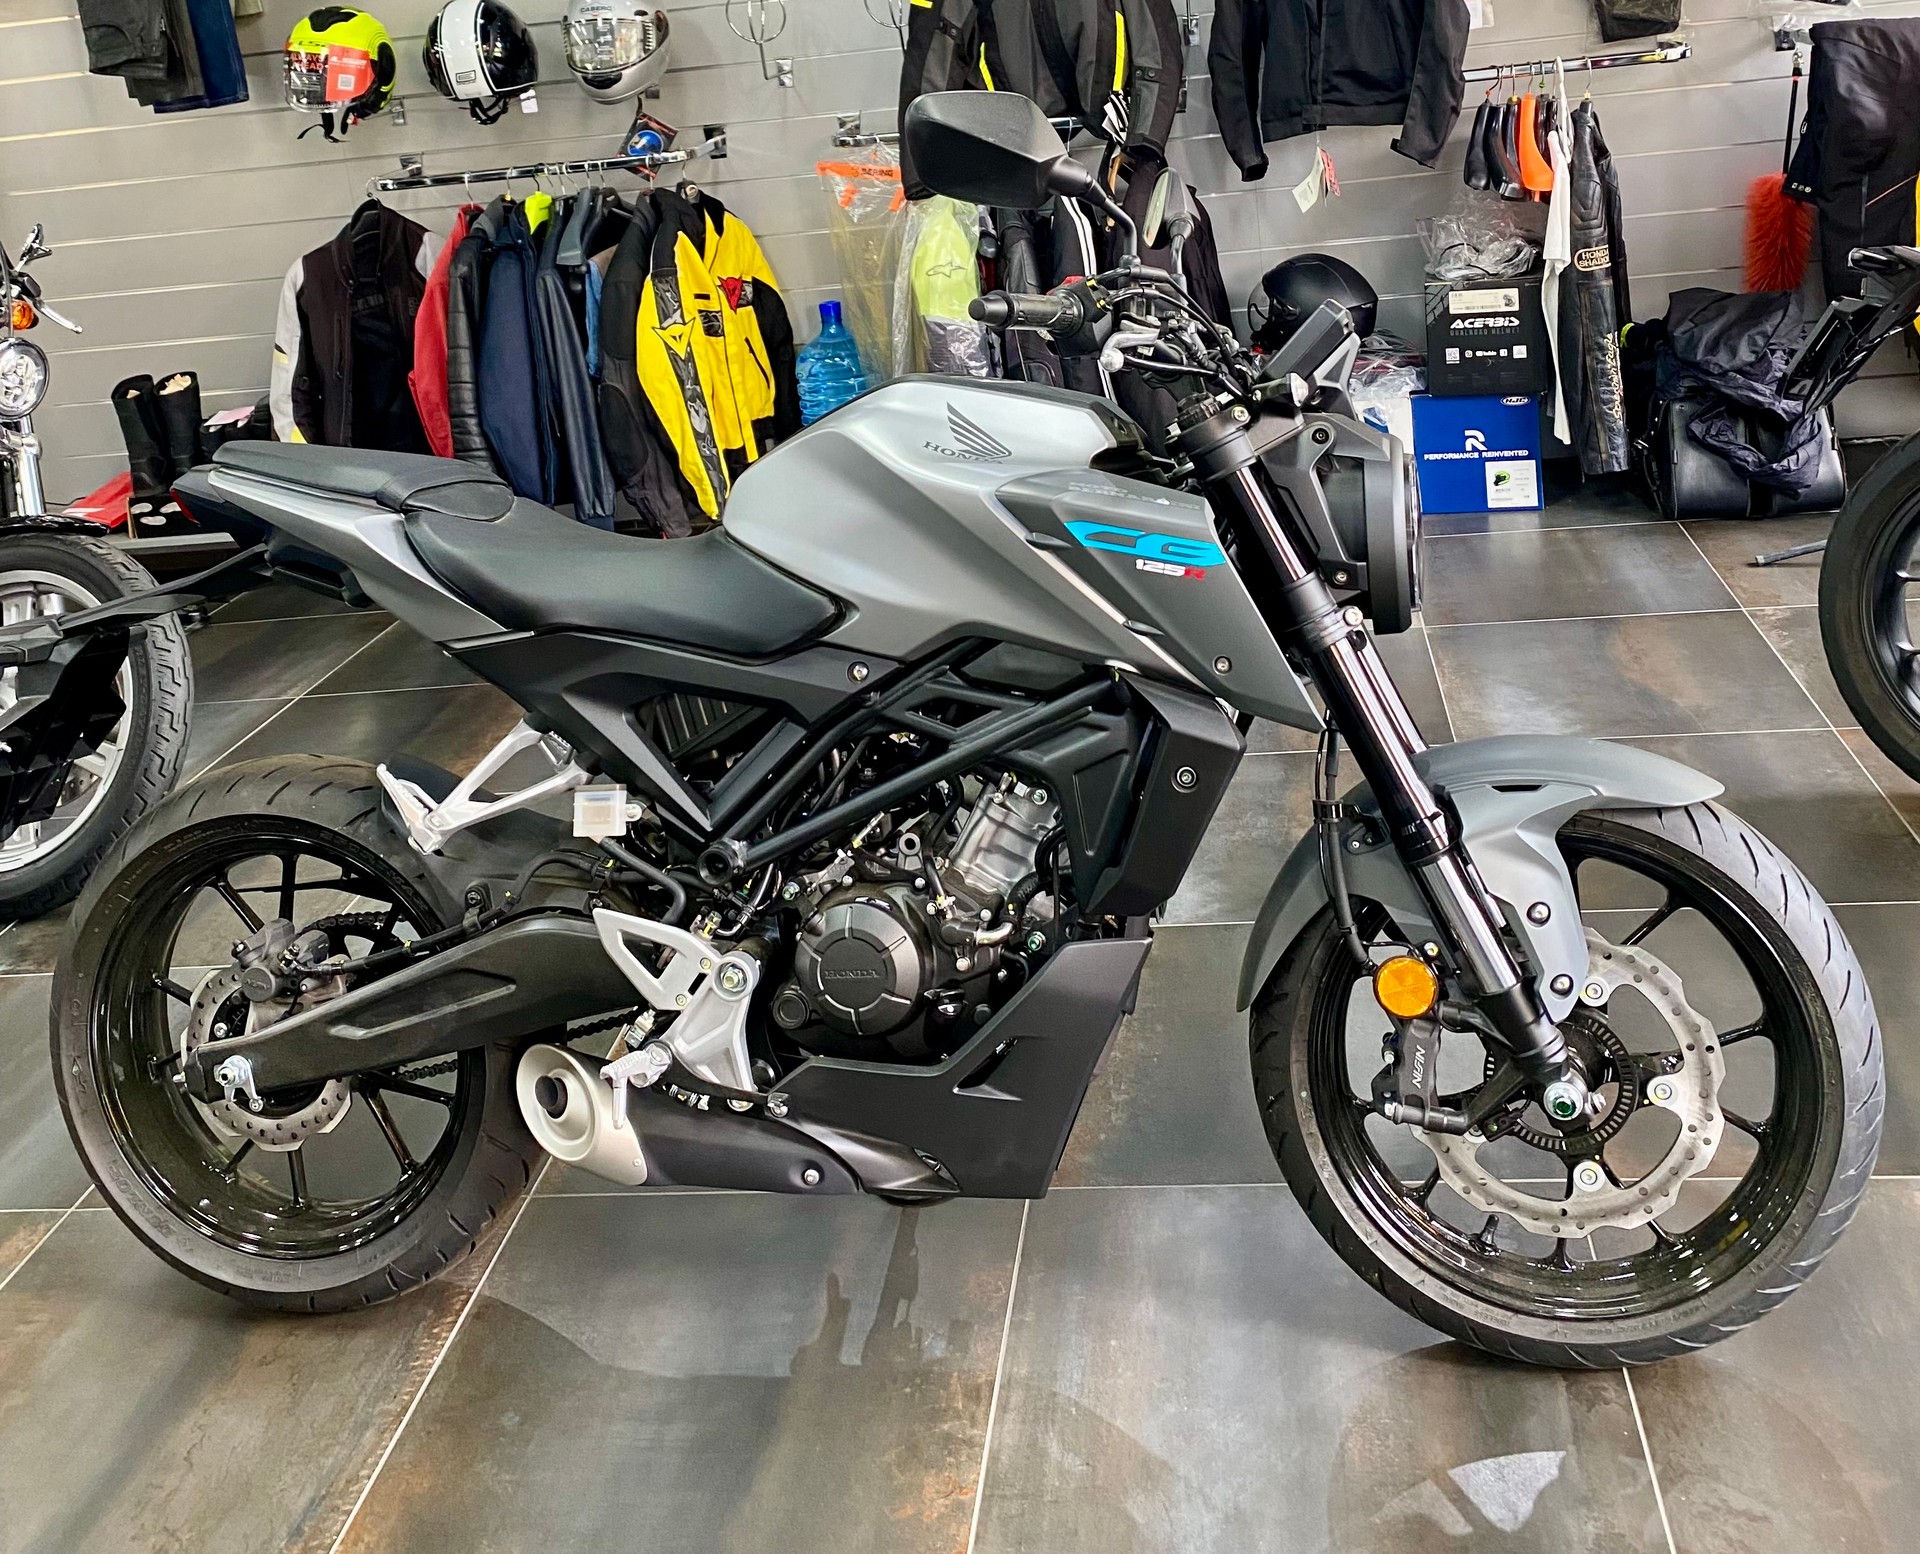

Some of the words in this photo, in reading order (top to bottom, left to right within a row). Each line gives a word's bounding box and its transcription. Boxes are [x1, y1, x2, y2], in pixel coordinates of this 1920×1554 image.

[1581, 249, 1610, 260] HOND
[1578, 255, 1610, 267] SHADO
[1450, 316, 1520, 329] ACERBIS
[1491, 326, 1520, 335] HELMET
[1424, 452, 1480, 461] PERFORMANCE
[1481, 449, 1529, 459] REINVENTED
[1135, 558, 1207, 582] 125R
[823, 967, 881, 979] HONDA
